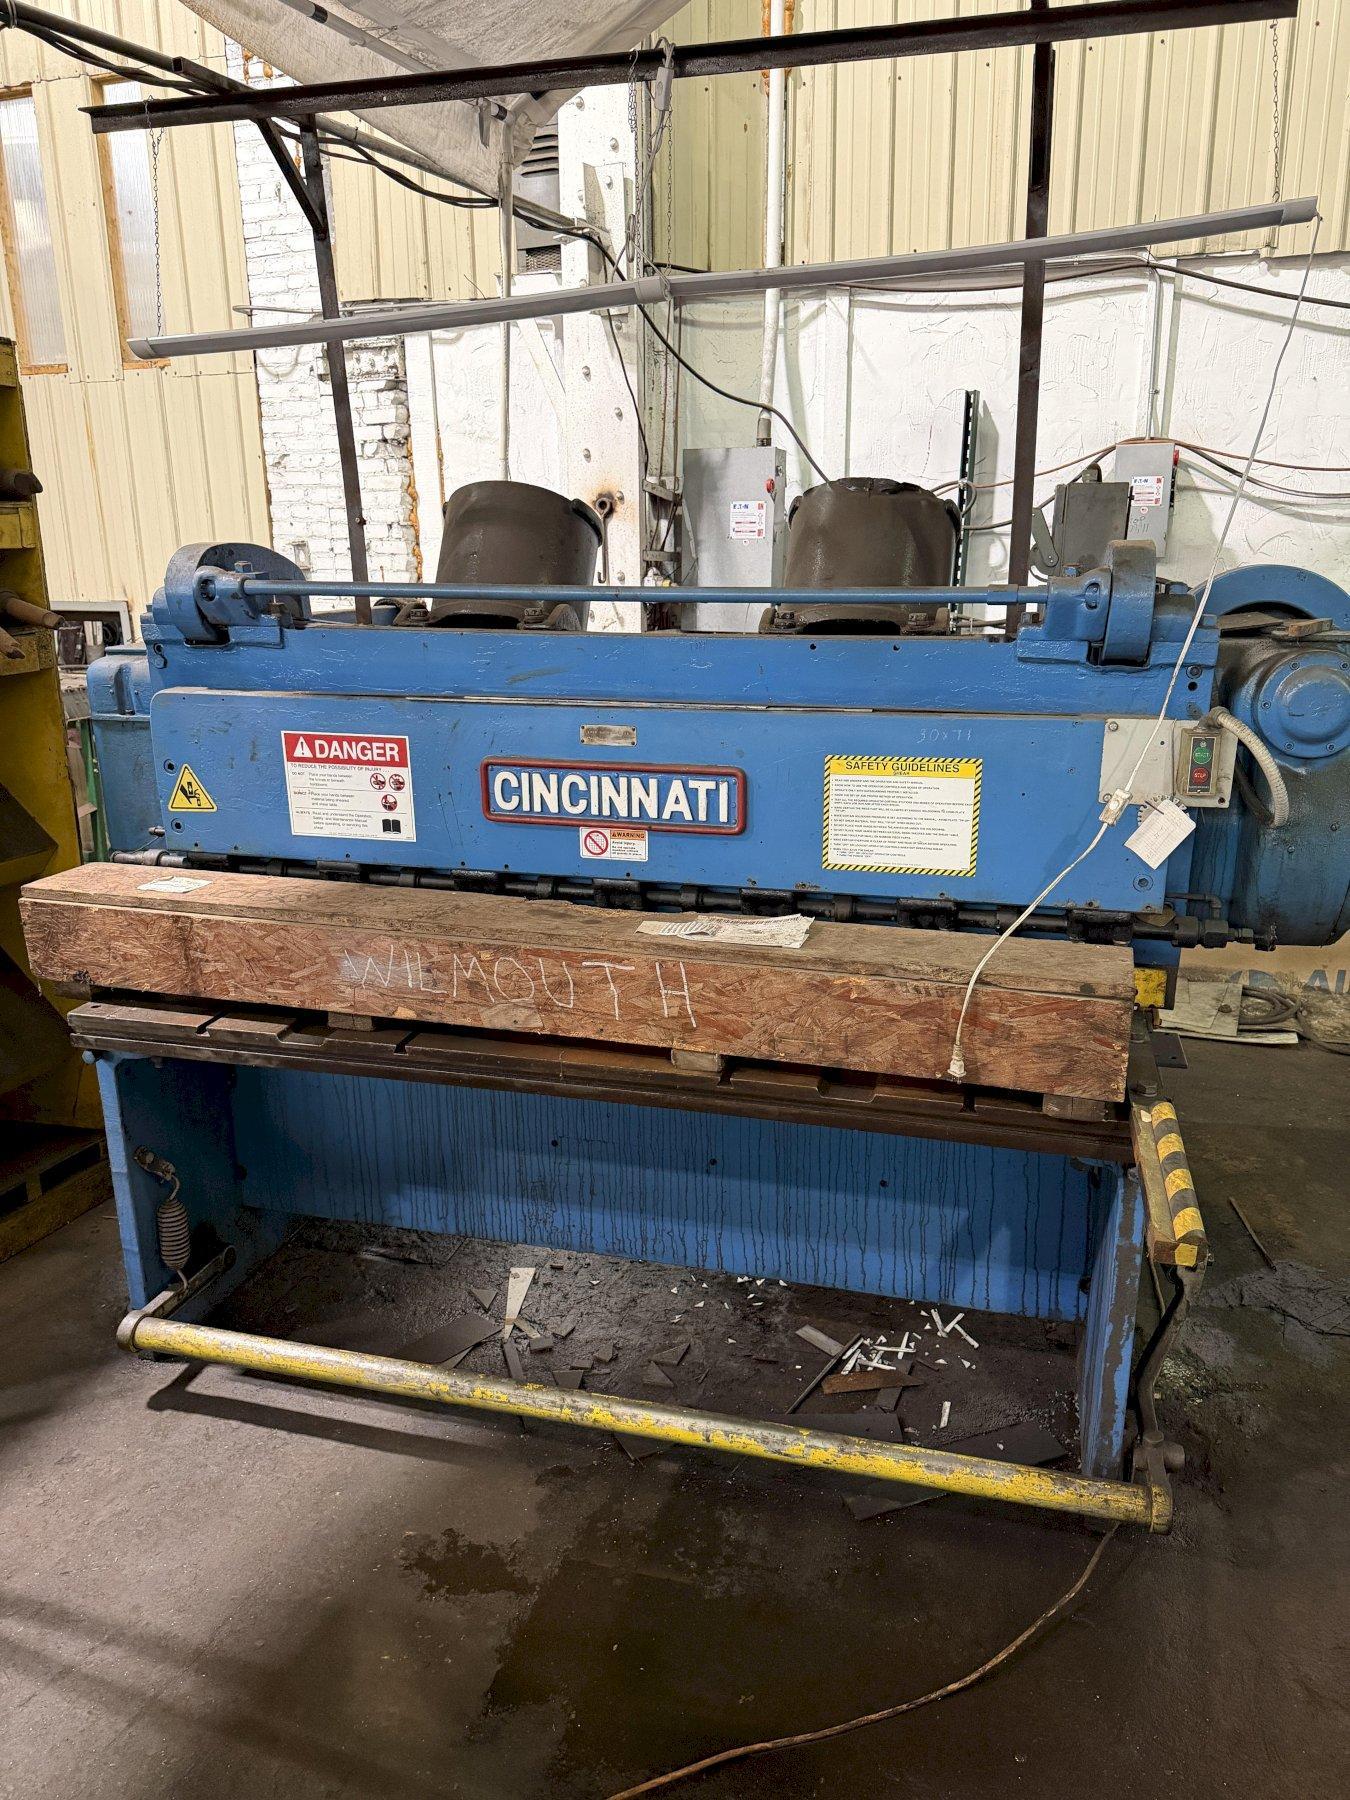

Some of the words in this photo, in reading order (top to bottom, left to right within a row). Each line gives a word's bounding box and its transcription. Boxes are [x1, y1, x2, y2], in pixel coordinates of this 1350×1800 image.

[314, 740, 400, 762] DANGER
[846, 761, 888, 771] SAFETY
[892, 762, 960, 773] GUIDELINES
[493, 771, 729, 823] CINCINNATI
